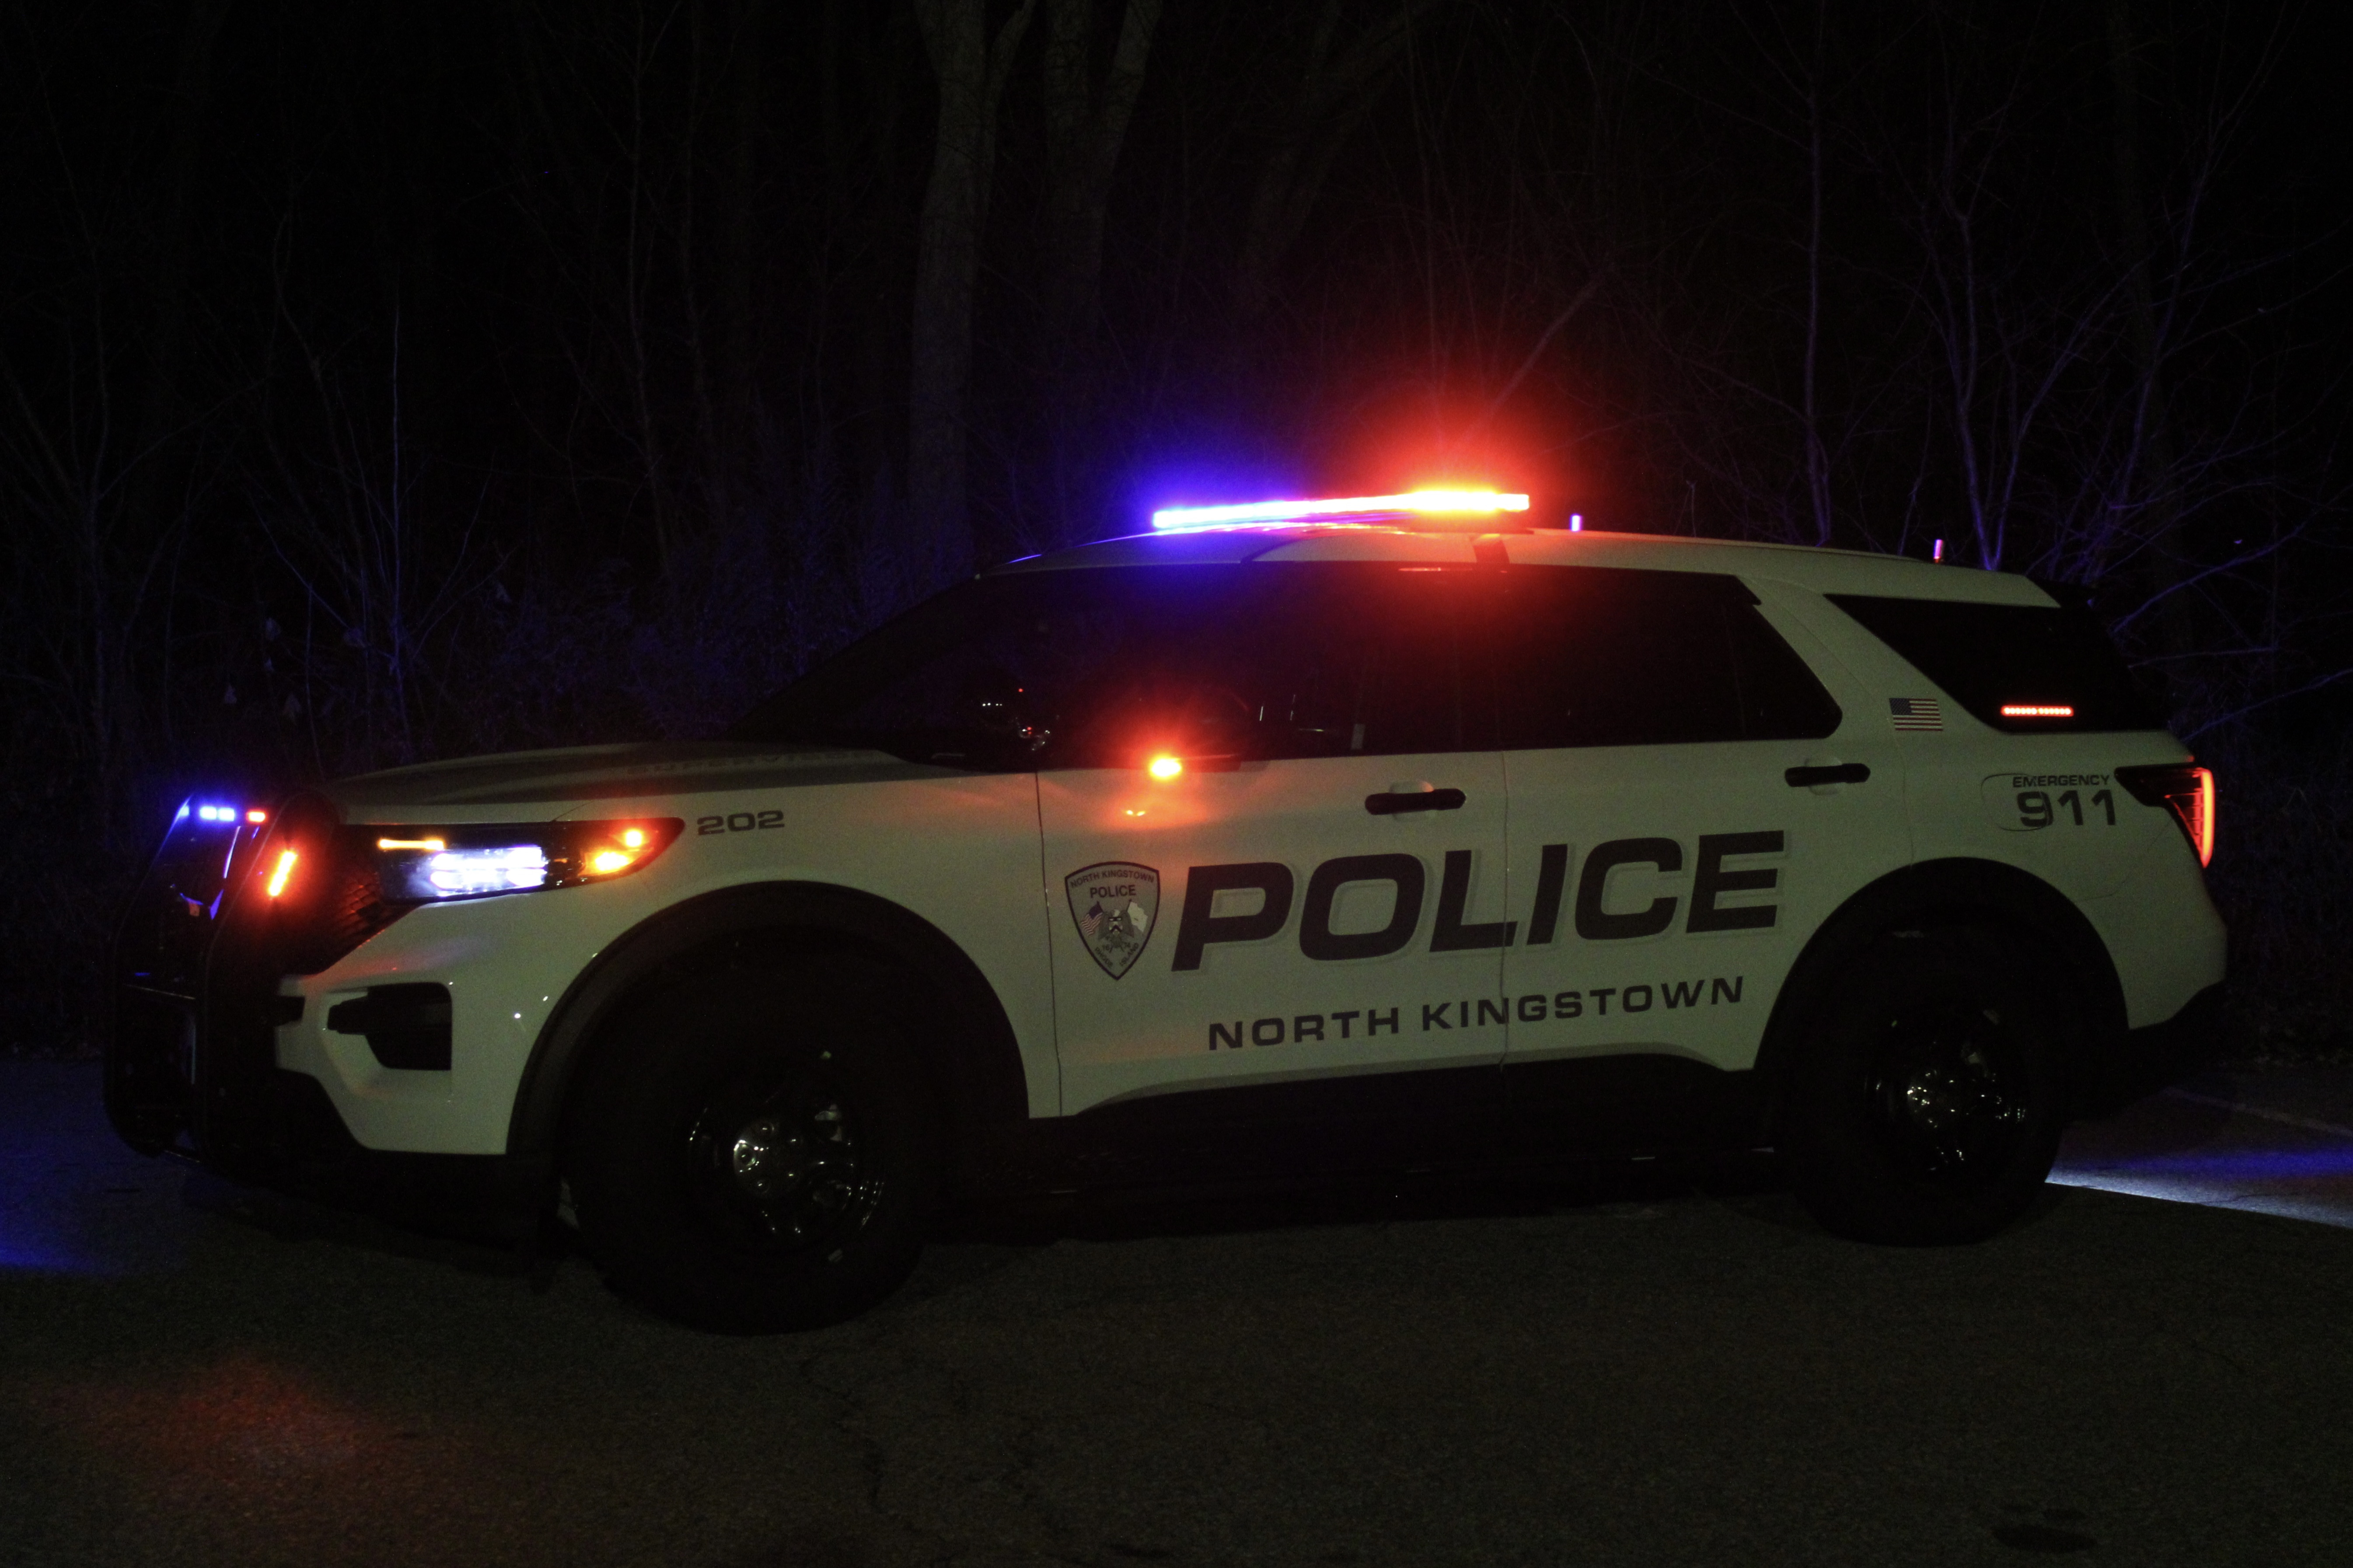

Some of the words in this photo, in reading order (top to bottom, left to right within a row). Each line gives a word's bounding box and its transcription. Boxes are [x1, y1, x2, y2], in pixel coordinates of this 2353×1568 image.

[2013, 775, 2109, 787] EMERGENCY
[2017, 789, 2116, 827] 911
[697, 810, 785, 835] 202
[1070, 872, 1100, 888] NORTH
[1102, 869, 1154, 883] KINGSTOWN
[1090, 885, 1137, 898] POLICE
[1171, 830, 1784, 972] POLICE
[1209, 1007, 1399, 1050] NORTH
[1422, 976, 1743, 1031] KINGSTOWN
